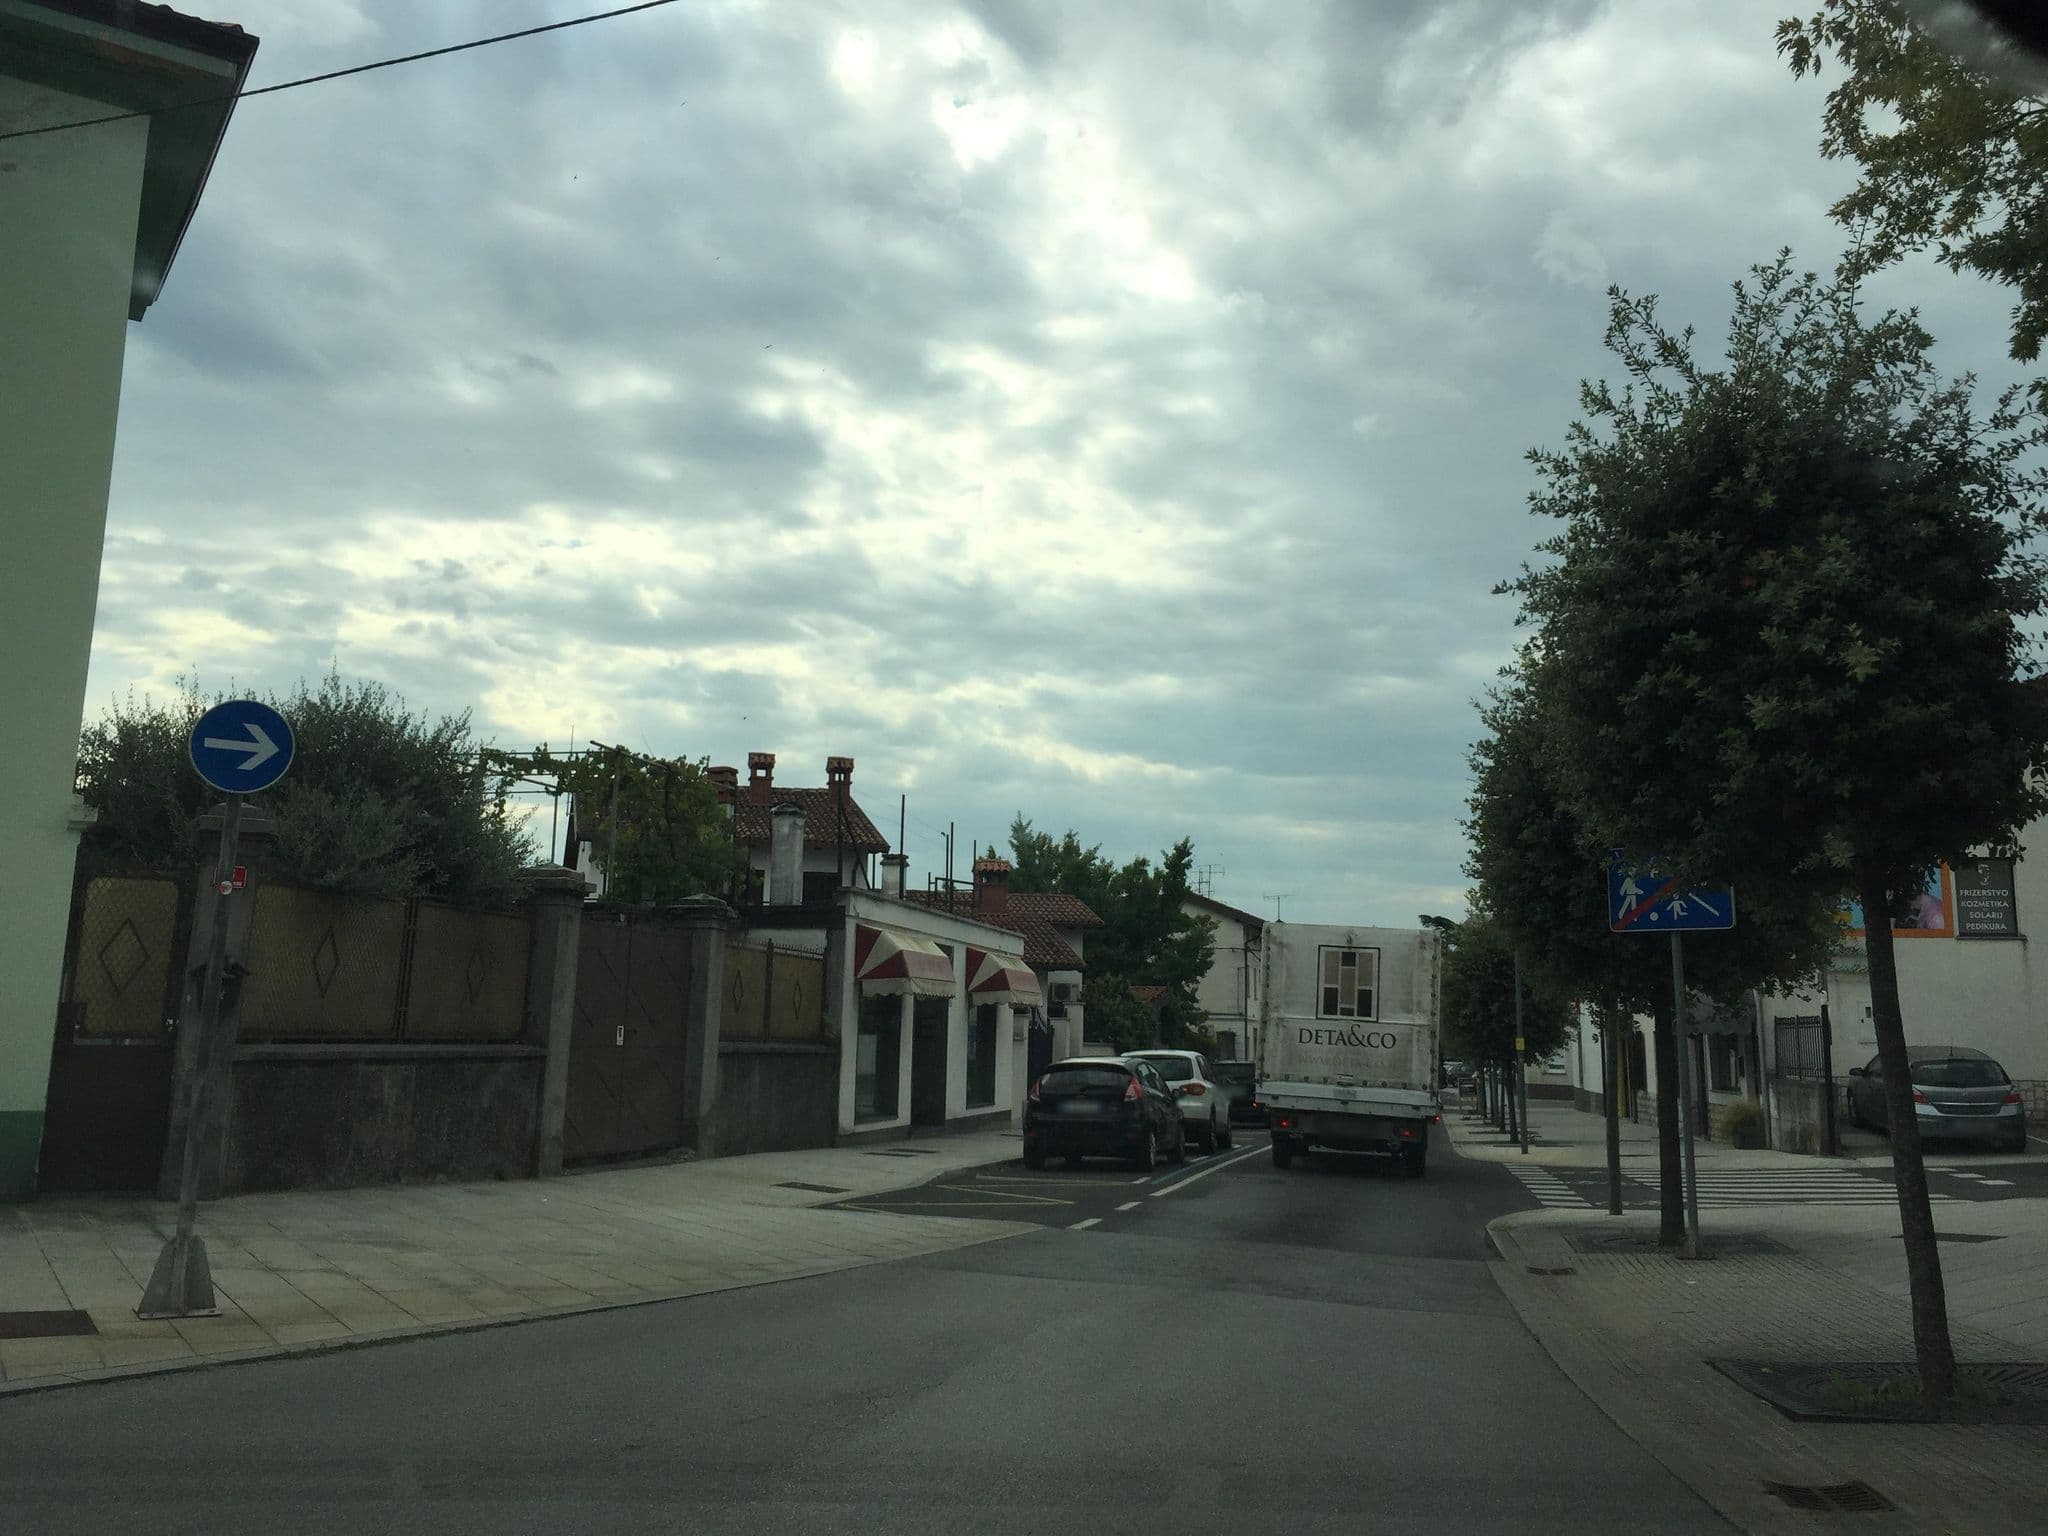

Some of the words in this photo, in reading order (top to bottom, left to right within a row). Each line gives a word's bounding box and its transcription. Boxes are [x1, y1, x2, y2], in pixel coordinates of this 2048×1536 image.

[1960, 889, 2009, 897] FRIZERSTVO
[1961, 900, 2009, 908] KOZMETIKA
[1298, 1024, 1397, 1049] DETA&CO
